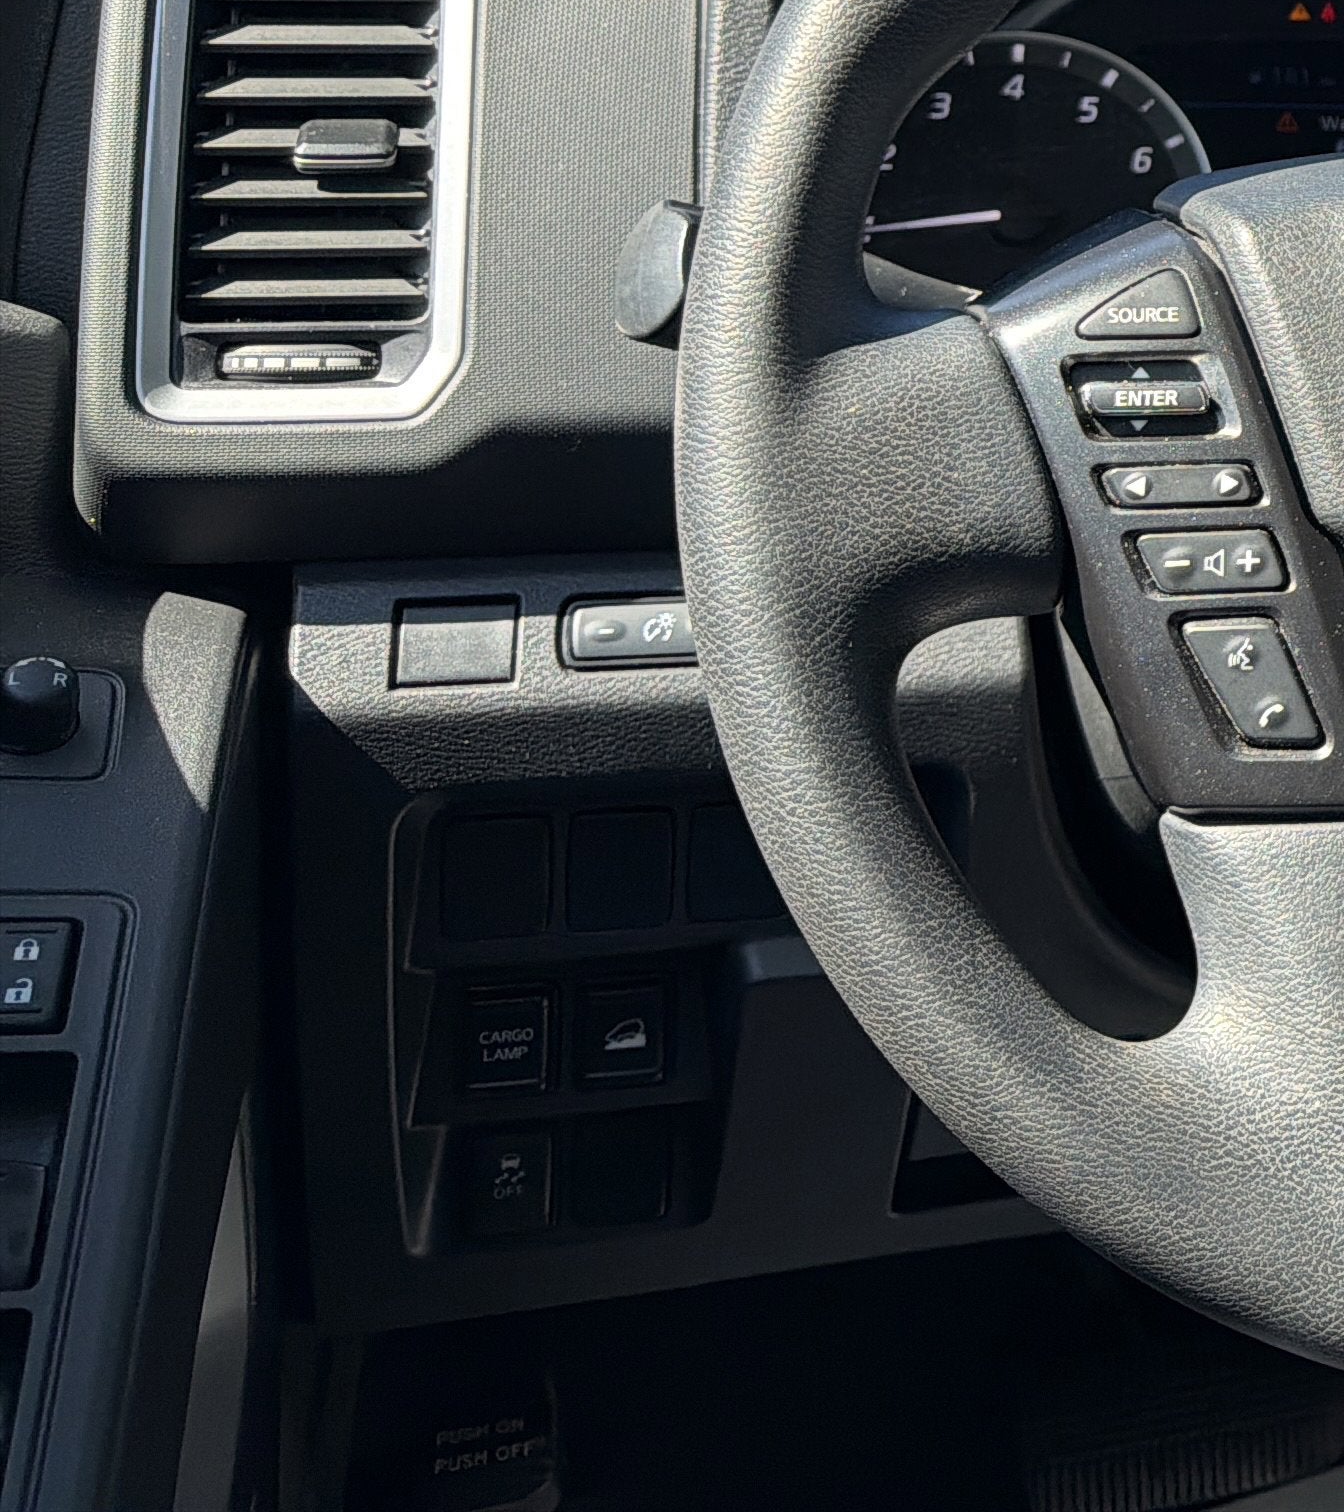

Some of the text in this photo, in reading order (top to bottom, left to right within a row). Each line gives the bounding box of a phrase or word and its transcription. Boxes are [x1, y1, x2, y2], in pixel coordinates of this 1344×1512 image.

[999, 73, 1026, 102] 4
[926, 91, 953, 120] 3
[1075, 96, 1101, 124] 5
[1130, 146, 1155, 175] 6
[1107, 306, 1180, 324] SOURCE
[1114, 389, 1179, 407] ENTER
[7, 670, 21, 686] L
[52, 672, 69, 688] R
[478, 1026, 535, 1046] CARGO
[480, 1045, 530, 1064] LAMP
[492, 1184, 525, 1201] OFF
[432, 1439, 538, 1475] PUSH OFF
